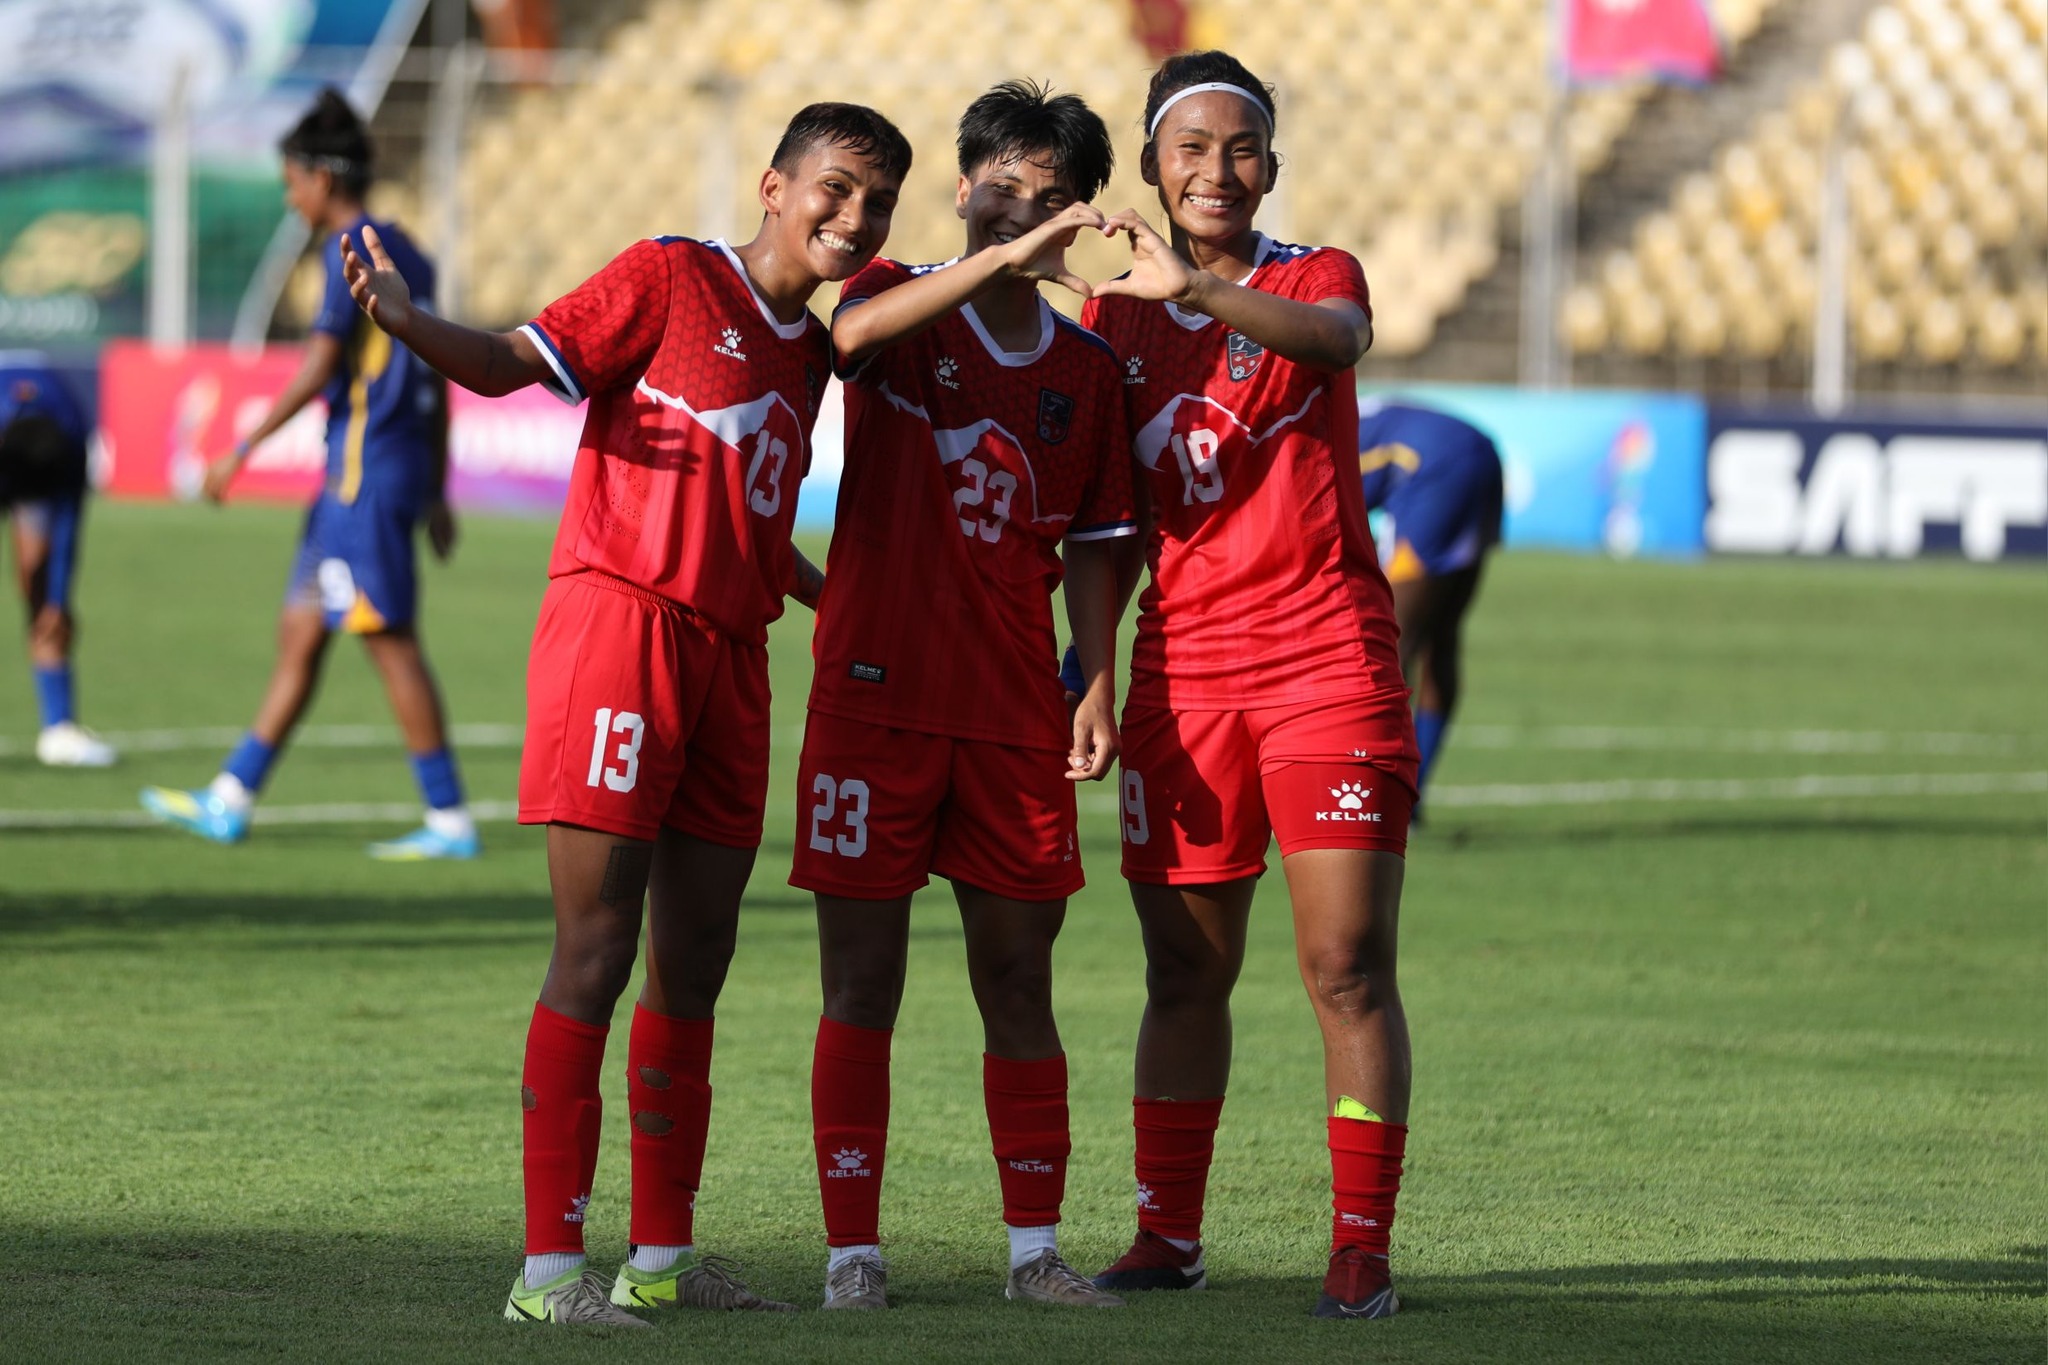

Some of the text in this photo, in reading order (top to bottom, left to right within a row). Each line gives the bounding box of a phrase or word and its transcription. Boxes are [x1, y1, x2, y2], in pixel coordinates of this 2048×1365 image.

[714, 344, 747, 361] KELME
[934, 368, 960, 389] LME
[746, 429, 788, 518] 13
[953, 458, 1018, 544] 23
[1170, 428, 1224, 506] 19
[1704, 428, 2046, 562] SAFF
[586, 707, 645, 793] 13
[809, 773, 870, 858] 23
[1315, 810, 1382, 822] KELME
[827, 1168, 871, 1178] KELME
[1009, 1160, 1053, 1173] KELME
